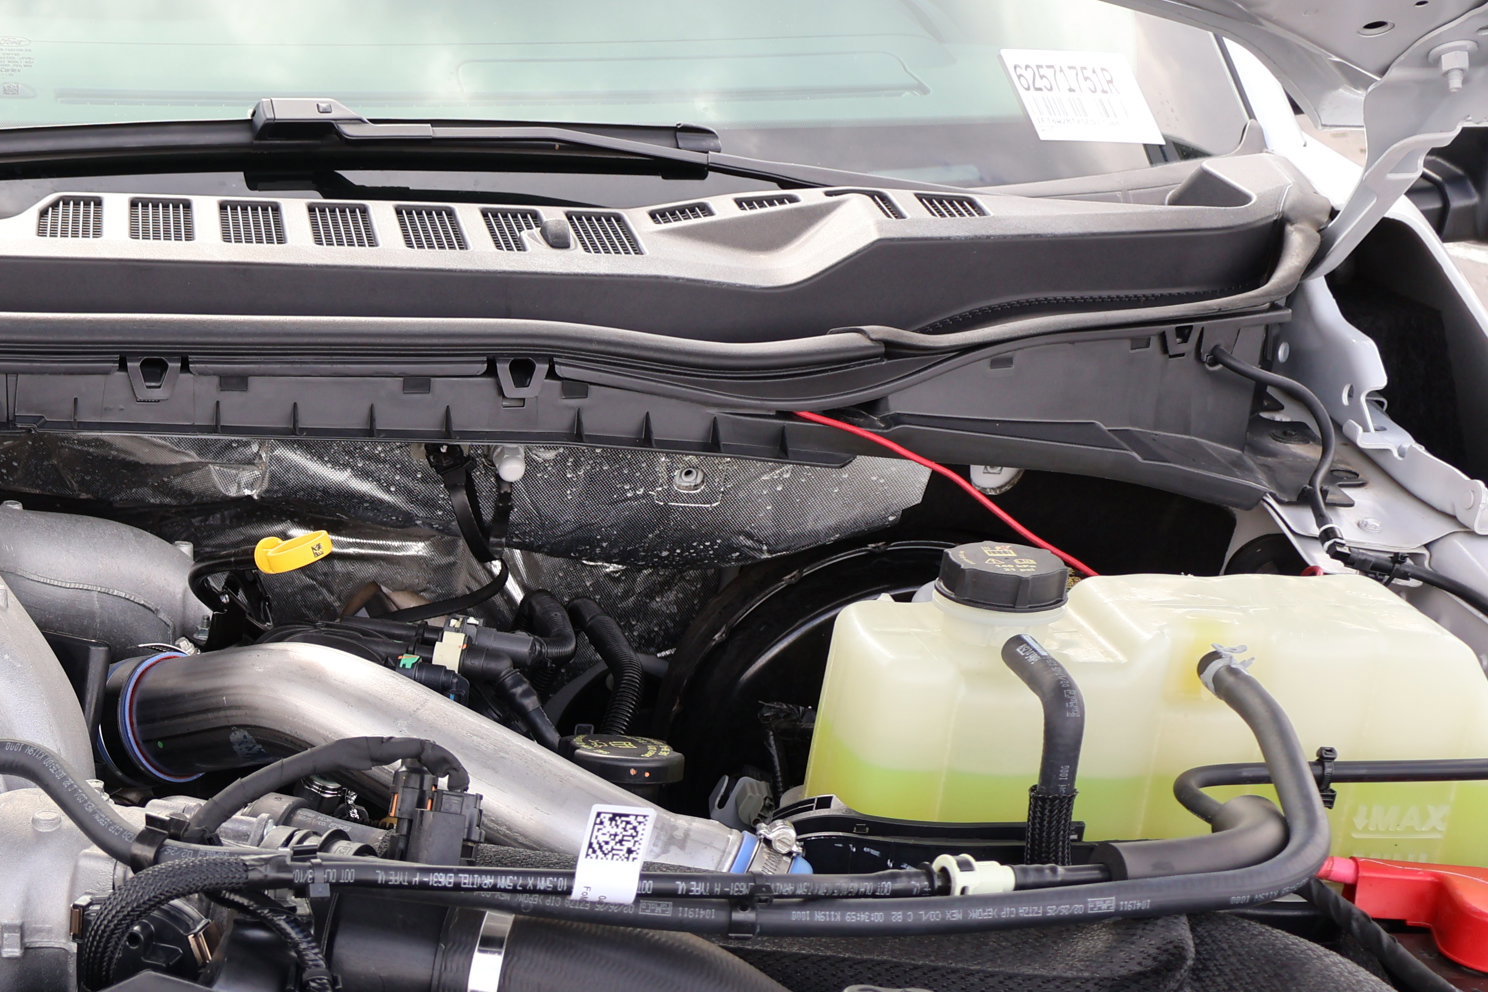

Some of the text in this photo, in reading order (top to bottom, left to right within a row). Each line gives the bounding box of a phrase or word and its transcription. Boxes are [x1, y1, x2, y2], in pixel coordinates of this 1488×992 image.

[1013, 64, 1121, 94] 62571751R
[1368, 805, 1451, 831] MAX
[375, 870, 386, 884] VL
[388, 871, 409, 885] TYPE
[526, 876, 534, 890] X
[689, 881, 710, 895] TYPE
[639, 902, 671, 915] FoMoCo
[678, 906, 716, 919] 1041911
[945, 910, 962, 920] MEX
